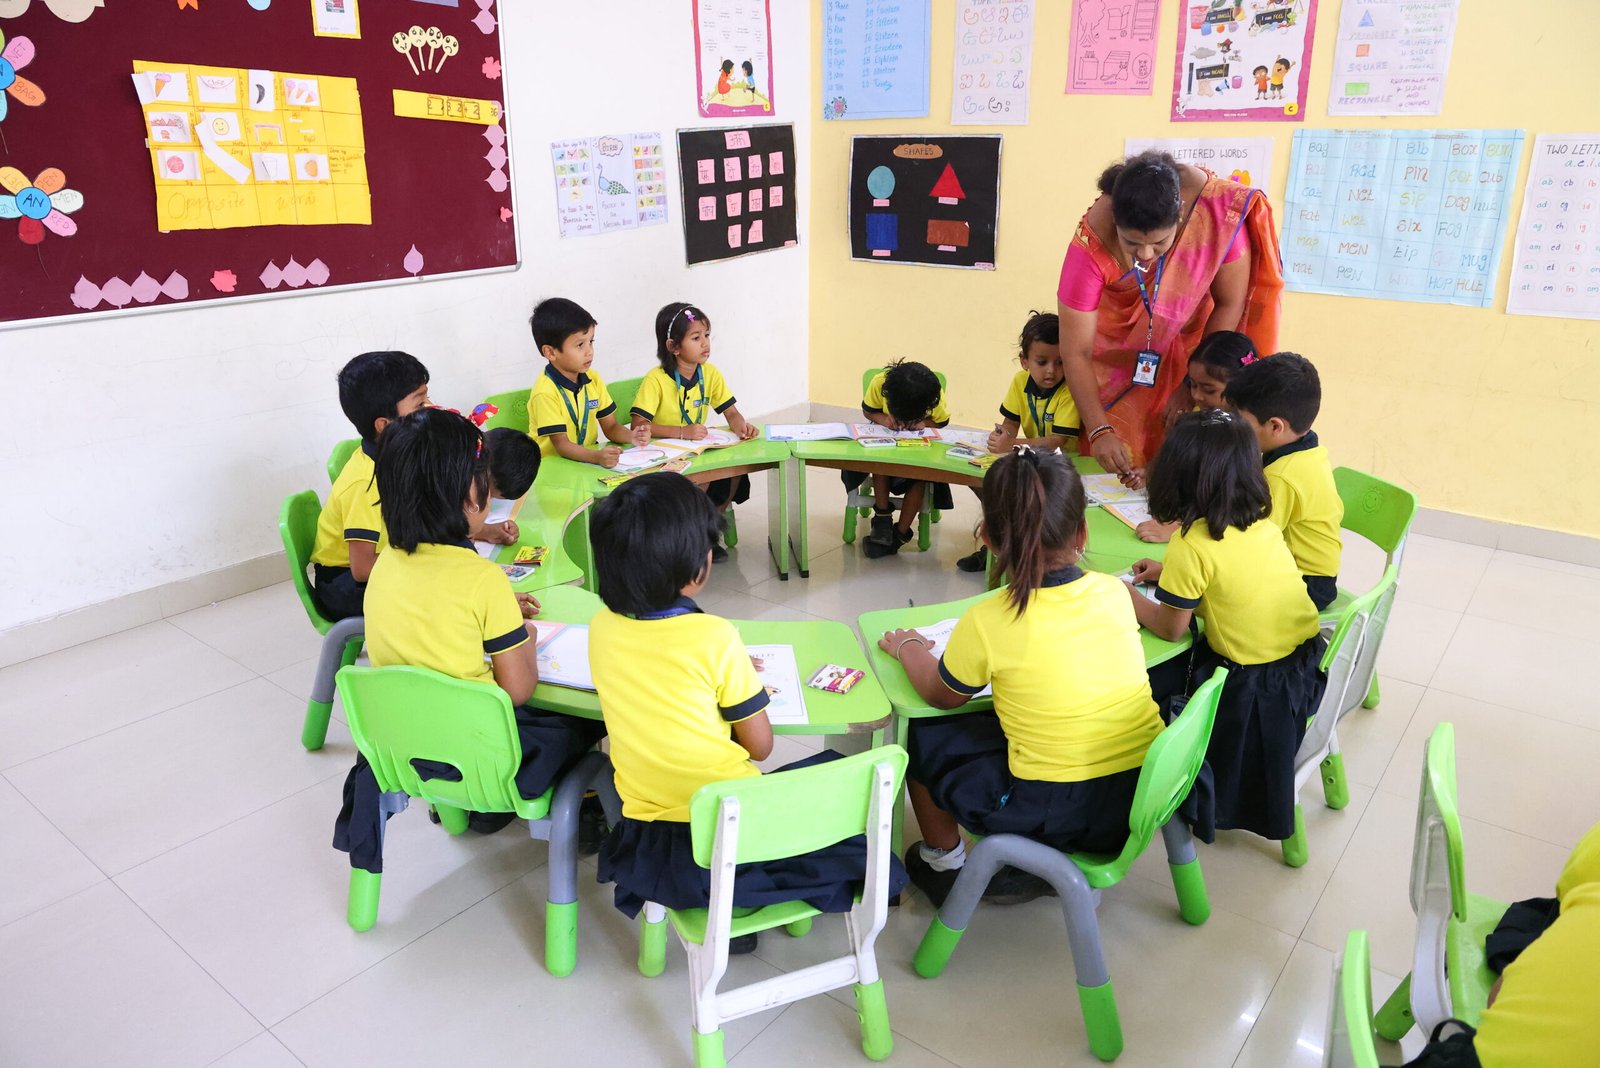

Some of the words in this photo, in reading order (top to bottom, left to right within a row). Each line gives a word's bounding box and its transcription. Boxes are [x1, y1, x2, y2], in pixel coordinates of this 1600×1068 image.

[1173, 148, 1215, 159] LETTERED
[1220, 148, 1248, 158] WORDS
[1546, 144, 1569, 155] TWO
[1571, 144, 1600, 156] LETT
[22, 193, 45, 208] AN
